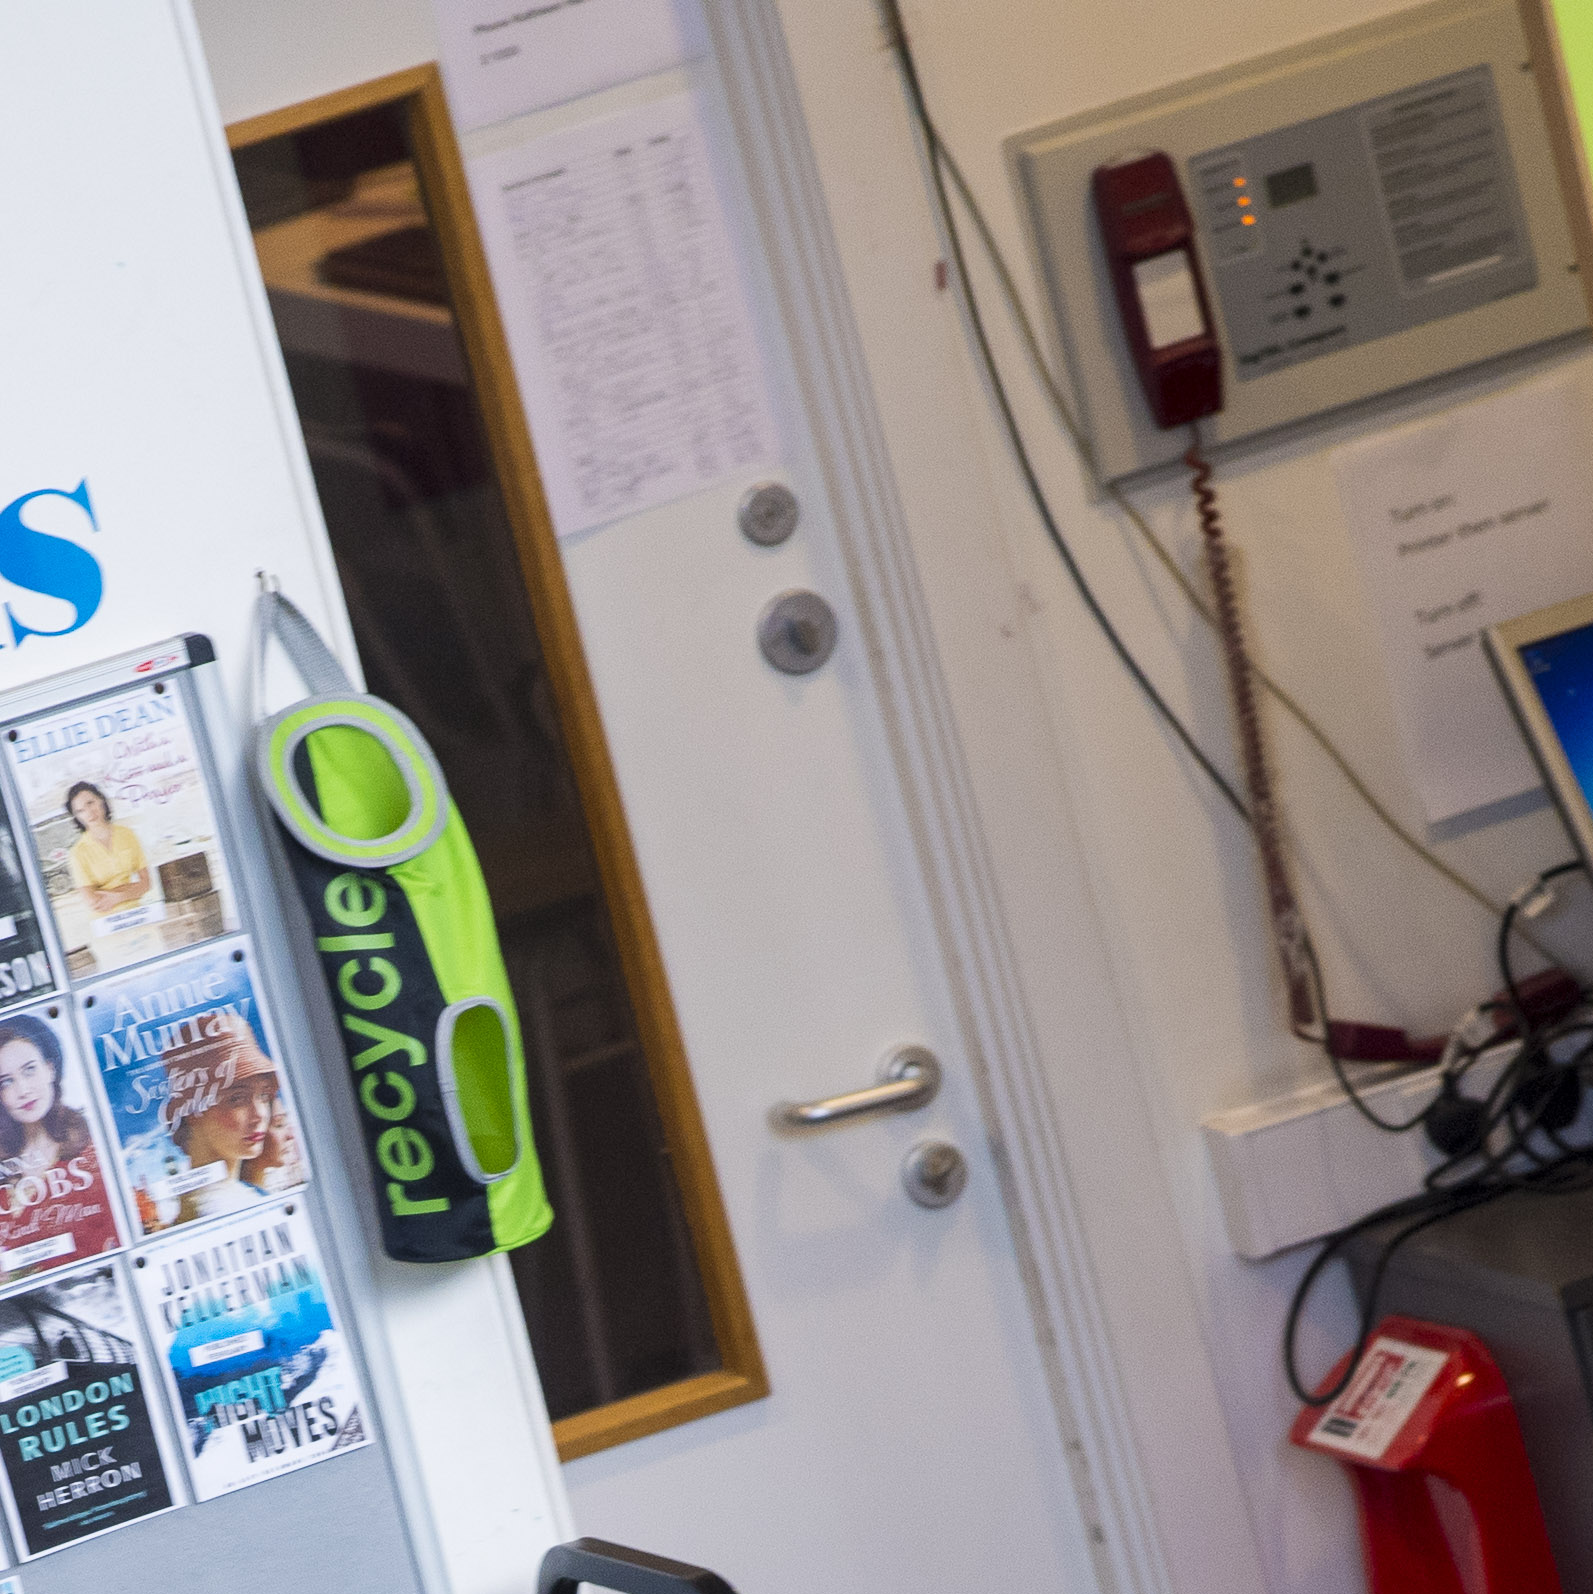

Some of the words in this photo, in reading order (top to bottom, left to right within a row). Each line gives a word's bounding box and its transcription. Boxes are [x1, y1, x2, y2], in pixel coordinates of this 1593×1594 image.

[16, 719, 90, 764] ELLIE
[96, 694, 179, 740] DEAN
[111, 968, 227, 1030] Annie
[99, 996, 251, 1071] Murray
[316, 870, 452, 1217] recycle
[17, 1404, 131, 1462] RULES
[240, 1396, 339, 1463] MOVES
[36, 1461, 142, 1512] HERRON
[50, 1445, 118, 1483] MICK
